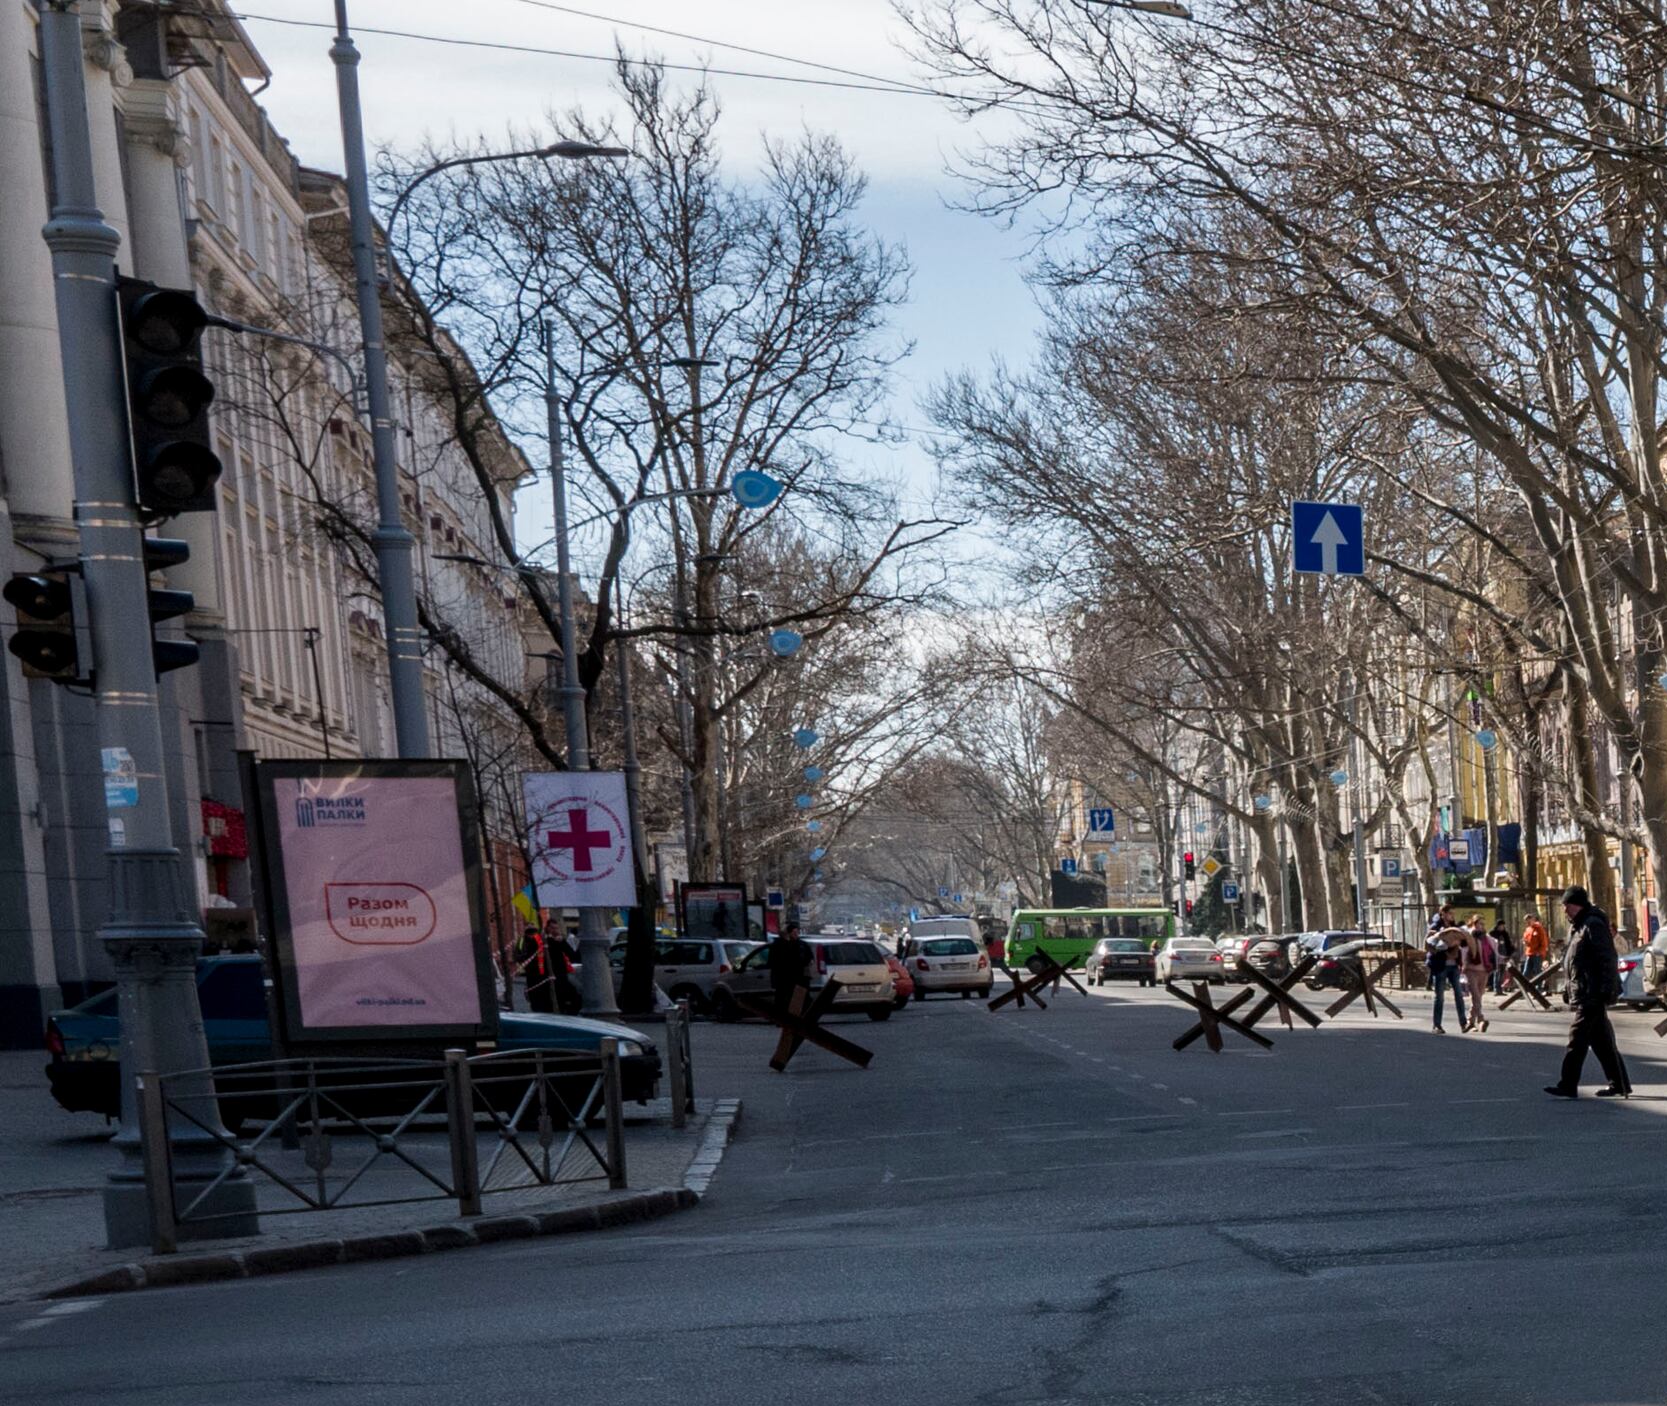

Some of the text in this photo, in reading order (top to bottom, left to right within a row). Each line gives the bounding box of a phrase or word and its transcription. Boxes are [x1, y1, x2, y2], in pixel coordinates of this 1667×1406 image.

[314, 797, 365, 808] ВИЛКИ
[316, 809, 366, 821] ПАЛКИ
[347, 897, 409, 910] Разом
[350, 916, 417, 929] щодня
